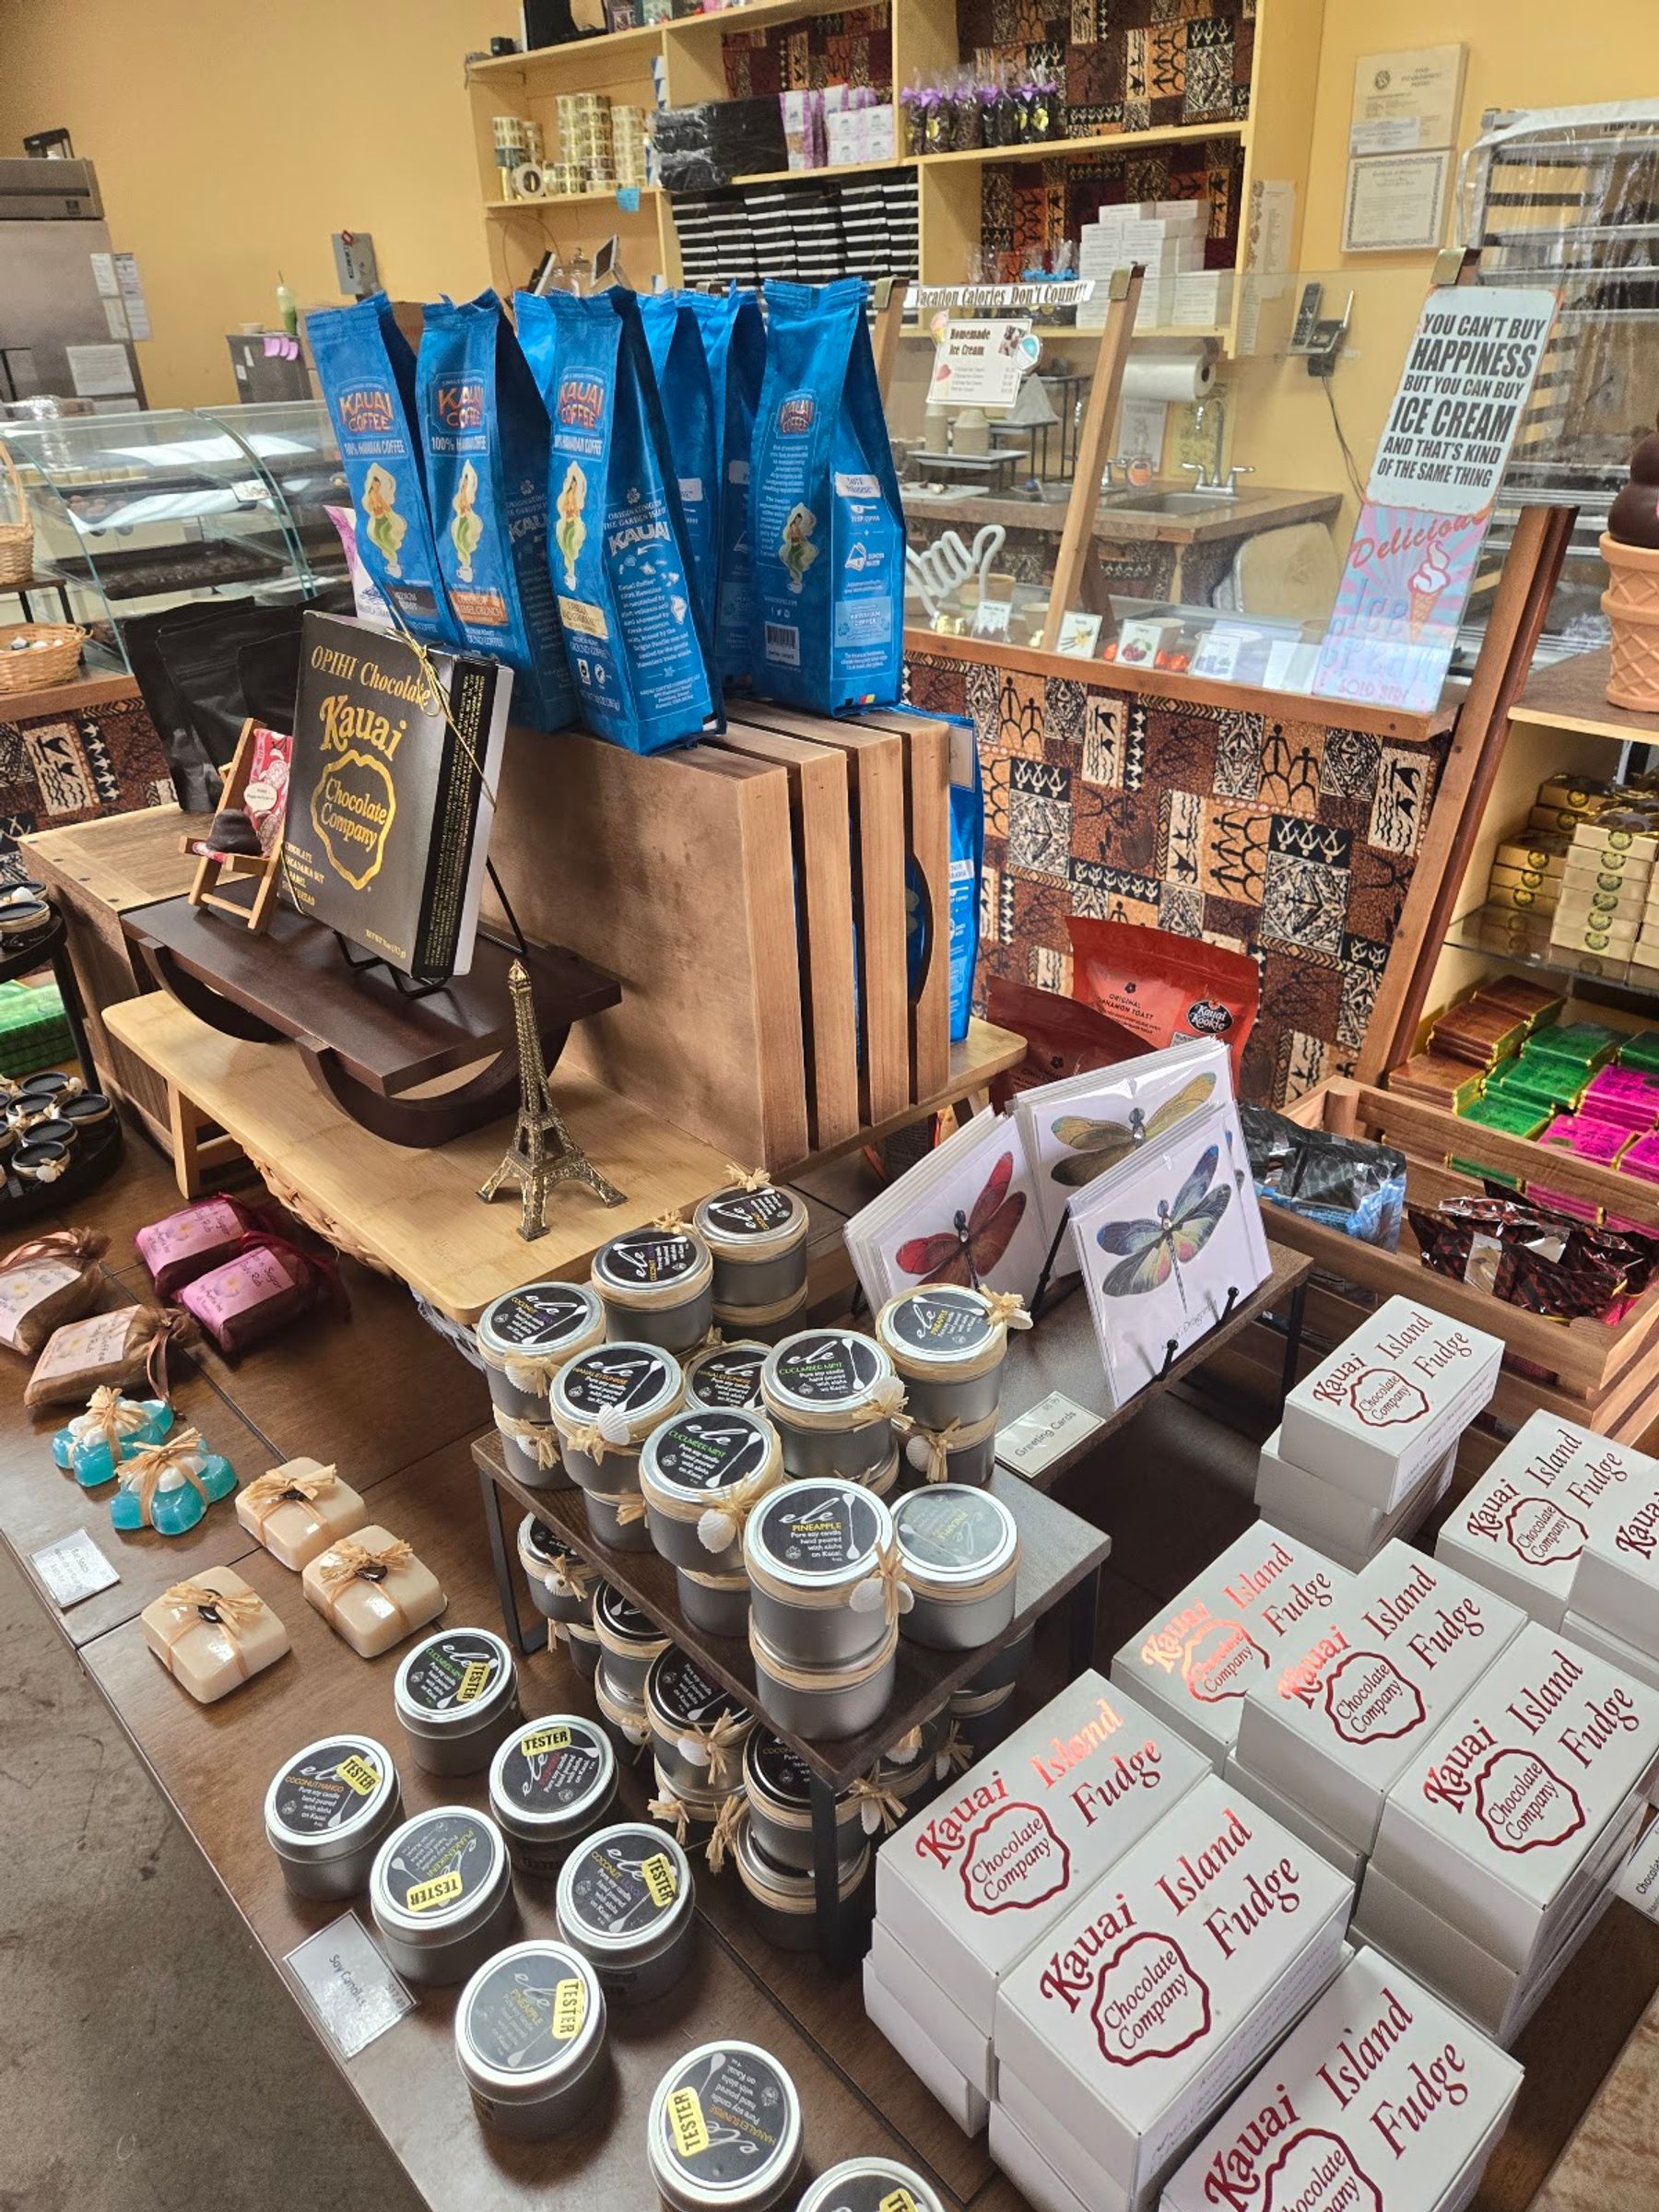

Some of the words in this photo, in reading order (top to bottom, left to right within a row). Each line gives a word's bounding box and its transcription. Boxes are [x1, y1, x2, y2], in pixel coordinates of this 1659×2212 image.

[916, 288, 959, 306] Vacation
[962, 287, 1005, 305] Calories
[1012, 285, 1041, 303] Don't
[950, 328, 990, 339] Homemade
[1423, 314, 1456, 335] YOU
[1457, 315, 1508, 338] CAN'T
[1508, 318, 1546, 340] BUY
[949, 344, 959, 356] Ice
[961, 345, 984, 356] Cream
[1410, 337, 1537, 378] HAPPINESS
[338, 391, 394, 424] KAUAI
[559, 382, 604, 416] KAUAI
[1404, 375, 1432, 393] BUT
[1433, 376, 1460, 394] YOU
[1462, 379, 1491, 397] CAN
[1494, 382, 1524, 400] BUY
[348, 413, 393, 432] COFFEE
[560, 404, 596, 429] COFFEE
[1390, 396, 1431, 434] ICE
[1431, 399, 1516, 442] CREAM
[382, 440, 405, 453] COFFEE
[432, 437, 454, 451] 100%
[1383, 436, 1413, 455] AND
[1415, 439, 1463, 461] THAT'S
[1465, 443, 1501, 465] KIND
[1377, 458, 1394, 476] OF
[1394, 460, 1417, 479] THE
[1418, 463, 1453, 483] SAME
[1453, 465, 1493, 488] THING
[312, 645, 358, 679] OPIHI
[360, 663, 430, 705] Chocolate
[319, 695, 407, 761] Kauai
[325, 778, 386, 825] Chocolate
[321, 803, 378, 853] Company
[1109, 994, 1141, 1009] ORIGINAL
[1132, 1008, 1154, 1020] TOAST
[1191, 1012, 1225, 1032] Kookie
[1197, 1005, 1227, 1021] Kauai
[265, 1266, 284, 1289] Sugar
[1313, 1353, 1368, 1406] Kauai
[1374, 1312, 1432, 1361] Island
[1413, 1330, 1472, 1379] Fudge
[1359, 1373, 1399, 1413] Chocolate
[1371, 1383, 1411, 1422] Company
[1015, 1430, 1055, 1457] Greeting
[1051, 1411, 1077, 1430] Cards
[1466, 1478, 1521, 1543] Kauai
[1524, 1429, 1583, 1488] Island
[1566, 1452, 1628, 1509] Fudge
[792, 1522, 841, 1532] PINEAPPLE
[1517, 1505, 1556, 1548] Chocolate
[1530, 1517, 1570, 1559] Company
[1142, 1598, 1212, 1674] Kauai
[1222, 1542, 1295, 1611] Island
[1261, 1570, 1333, 1638] Fudge
[1278, 1624, 1352, 1709] Kauai
[1360, 1563, 1438, 1641] Island
[1407, 1594, 1486, 1670] Fudge
[463, 1665, 486, 1699] TESTER
[1203, 1643, 1254, 1695] Company
[1335, 1661, 1392, 1721] Chocolate
[1348, 1677, 1405, 1736] Company
[1558, 1684, 1640, 1769] Fudge
[524, 1731, 568, 1751] TESTER
[1424, 1718, 1499, 1814] Kauai
[1506, 1650, 1583, 1736] Island
[343, 1759, 376, 1790] TESTER
[915, 1769, 1009, 1871] Kauai
[1029, 1698, 1124, 1790] Island
[1068, 1737, 1163, 1829] Fudge
[1488, 1759, 1545, 1828] Chocolate
[1504, 1779, 1559, 1842] Company
[591, 1851, 623, 1879] COCONUT
[971, 1814, 1045, 1886] Chocolate
[982, 1835, 1053, 1902] Company
[410, 1878, 458, 1906] TESTER
[648, 1858, 675, 1901] TESTER
[1040, 1893, 1137, 2014] Kauai
[1154, 1807, 1253, 1918] Island
[1202, 1856, 1300, 1961] Fudge
[329, 1954, 345, 1973] Soy
[340, 1971, 367, 2007] Candles
[1103, 1945, 1178, 2031] Chocolate
[510, 1988, 544, 2027] PINEAPPLE
[559, 1982, 580, 2034] TESTER
[1117, 1971, 1189, 2051] Company
[714, 2083, 740, 2100] poured
[732, 2105, 745, 2117] soy
[739, 2098, 757, 2111] hand
[1205, 2083, 1300, 2212] Kauai
[1315, 1987, 1415, 2112] Island
[1369, 2042, 1469, 2160] Fudge
[673, 2092, 700, 2151] TESTER
[744, 2112, 760, 2126] Pure
[1282, 2145, 1347, 2212] hocolate
